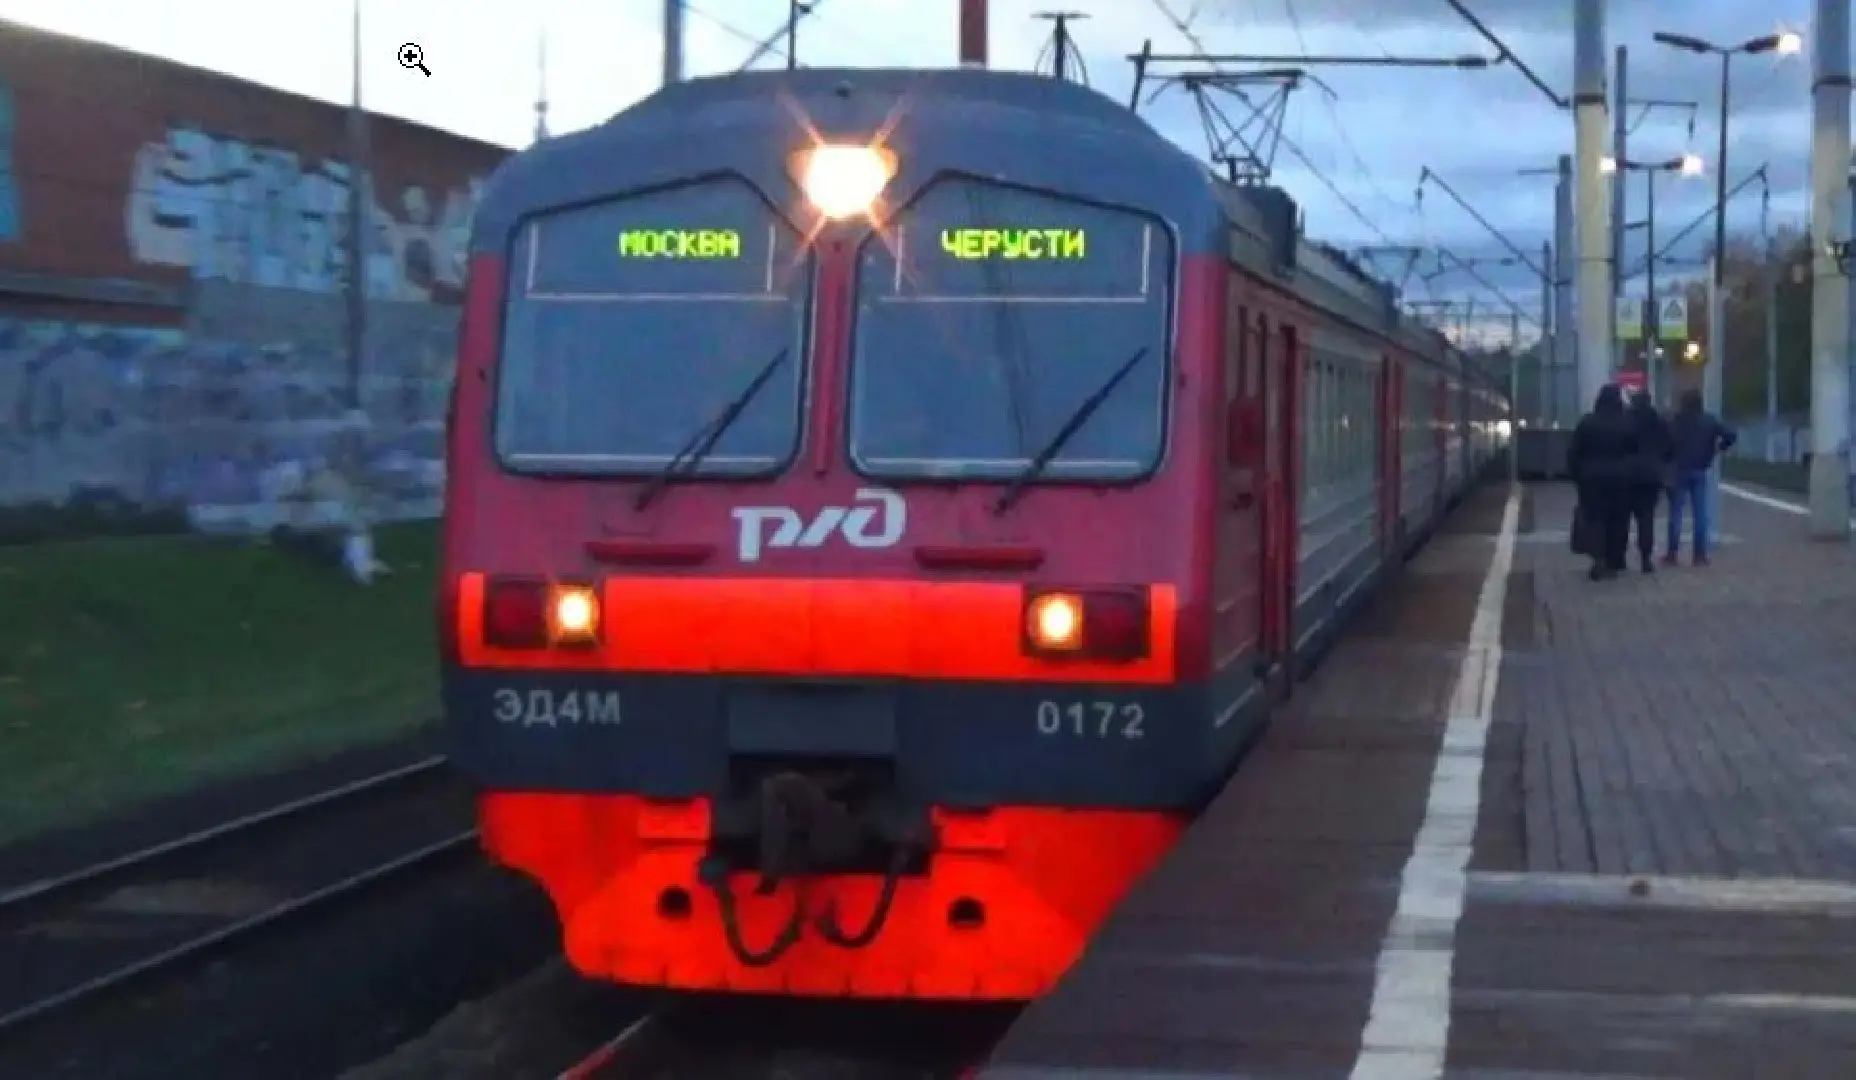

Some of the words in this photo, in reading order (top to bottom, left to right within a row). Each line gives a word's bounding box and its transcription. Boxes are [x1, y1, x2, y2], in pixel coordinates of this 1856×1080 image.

[619, 229, 741, 258] МОСКВА
[941, 228, 1086, 259] ЧЕРУСТИ
[494, 690, 622, 727] ЭД4М
[1036, 701, 1145, 738] 0172
